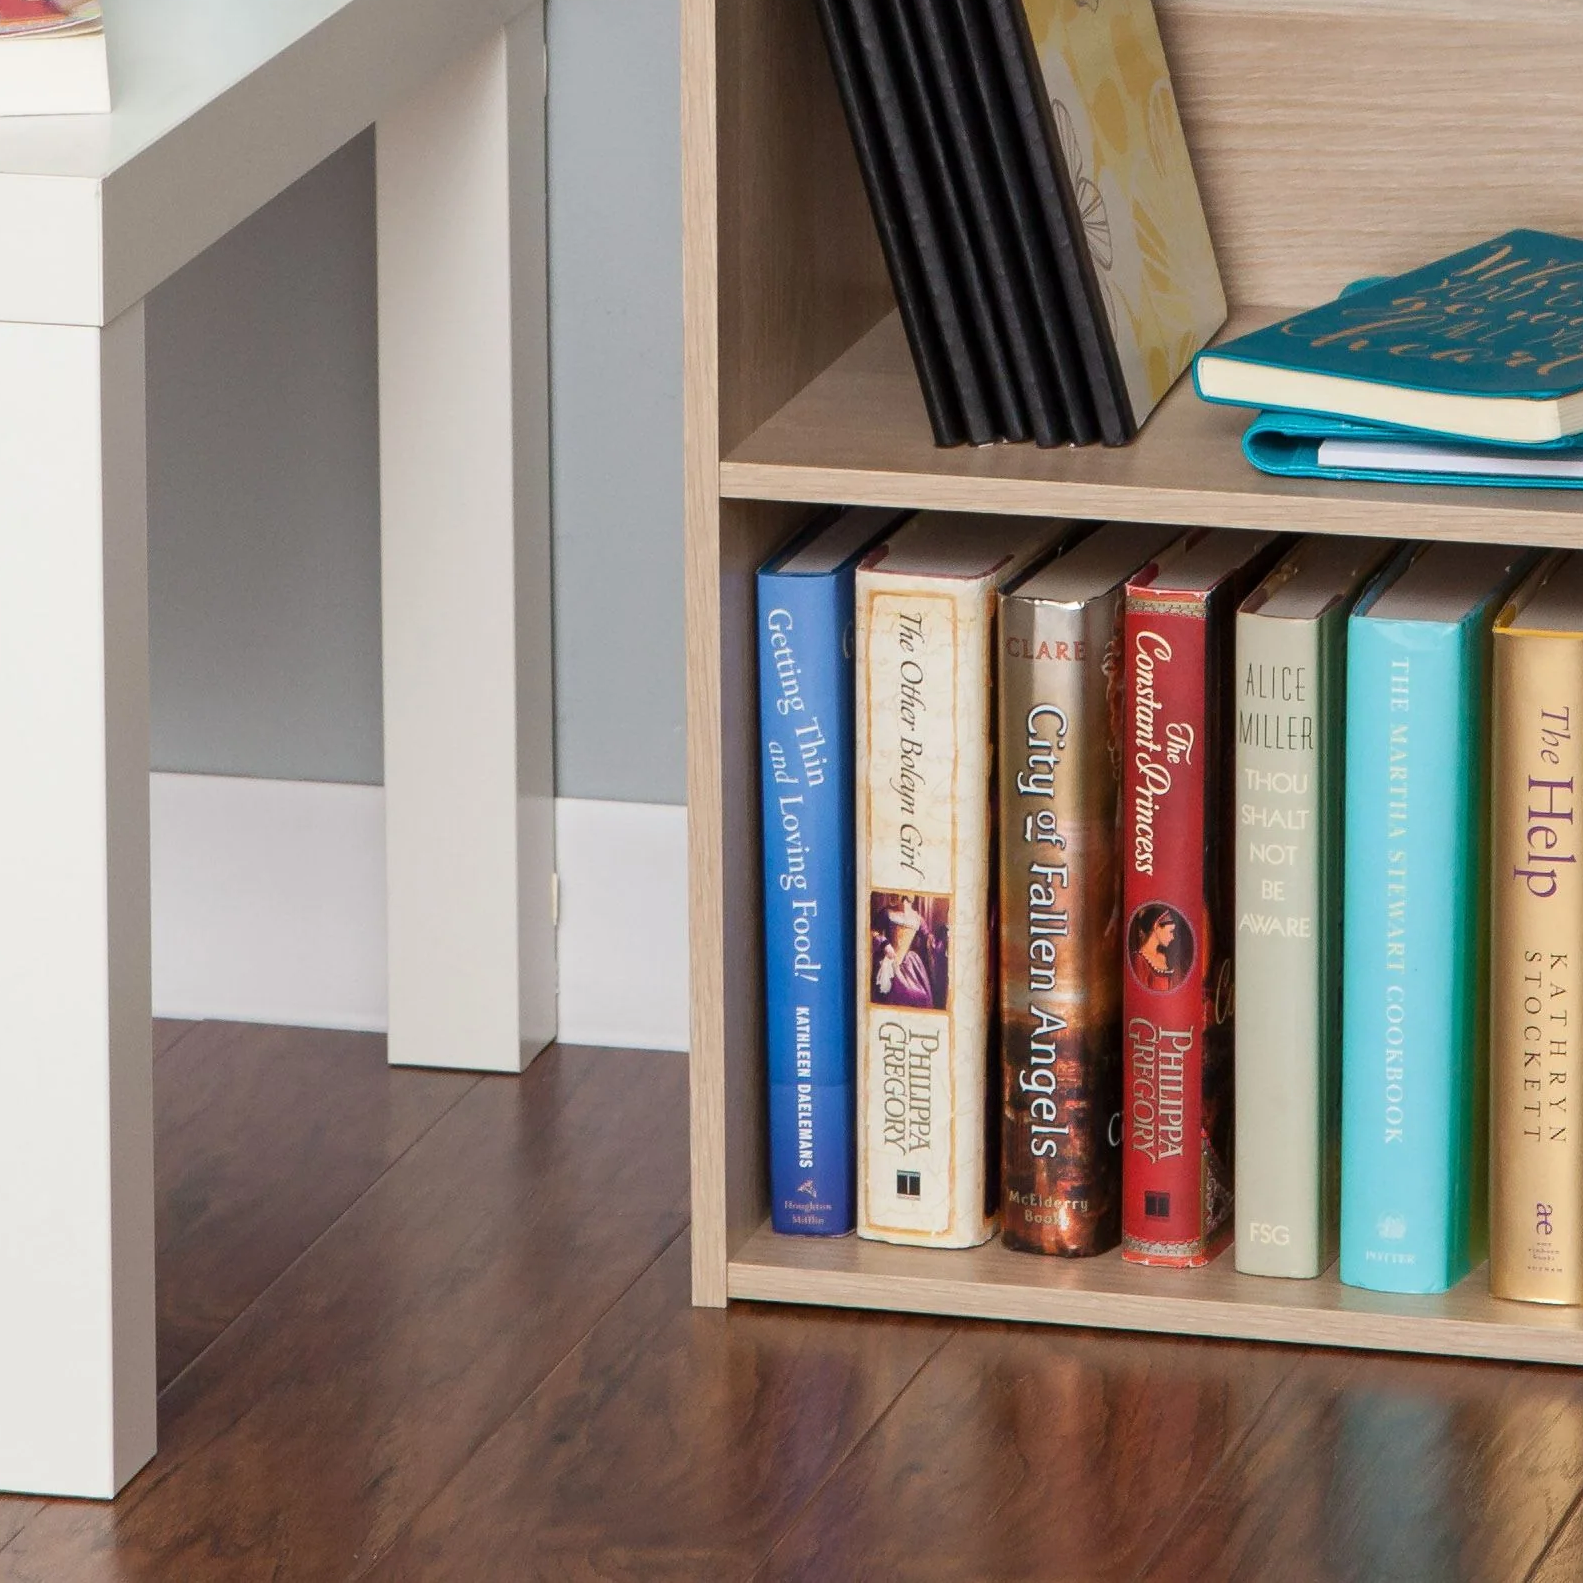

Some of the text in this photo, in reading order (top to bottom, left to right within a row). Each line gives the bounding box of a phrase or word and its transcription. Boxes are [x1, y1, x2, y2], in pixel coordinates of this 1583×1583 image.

[1006, 637, 1087, 661] CLARE
[1245, 663, 1305, 701] ALICE
[768, 608, 827, 787] Getting Thin
[1239, 709, 1313, 751] MILLER
[889, 612, 926, 880] The Other Boleyn Girl
[1136, 630, 1172, 877] Constant Princess
[1166, 722, 1194, 765] The
[1245, 768, 1308, 795] THOU
[1242, 804, 1310, 830] SHALT
[1513, 706, 1575, 900] The Help
[768, 741, 821, 983] and Loving Food!
[1249, 842, 1296, 867] NOT
[1262, 878, 1285, 902] BE
[1017, 704, 1070, 1159] City of Fallen Angels
[1238, 913, 1312, 939] AWARE
[1385, 657, 1410, 1144] THE MARTHA STEWART COOKBOOK
[796, 1006, 814, 1168] KATHLEEN DAELEMANS
[878, 1021, 907, 1156] GREGORY
[1523, 951, 1543, 1143] STOCKETT
[1548, 951, 1568, 1143] KATHRYN
[908, 1028, 939, 1152] PHILIPPA
[1128, 1017, 1157, 1164] GREGORY
[1157, 1026, 1194, 1159] PHILIPPA
[784, 1200, 832, 1211] Houghton
[792, 1214, 826, 1225] Mifflin
[1009, 1190, 1089, 1212] McElderry
[1025, 1209, 1070, 1228] Books
[1250, 1222, 1291, 1246] FSG
